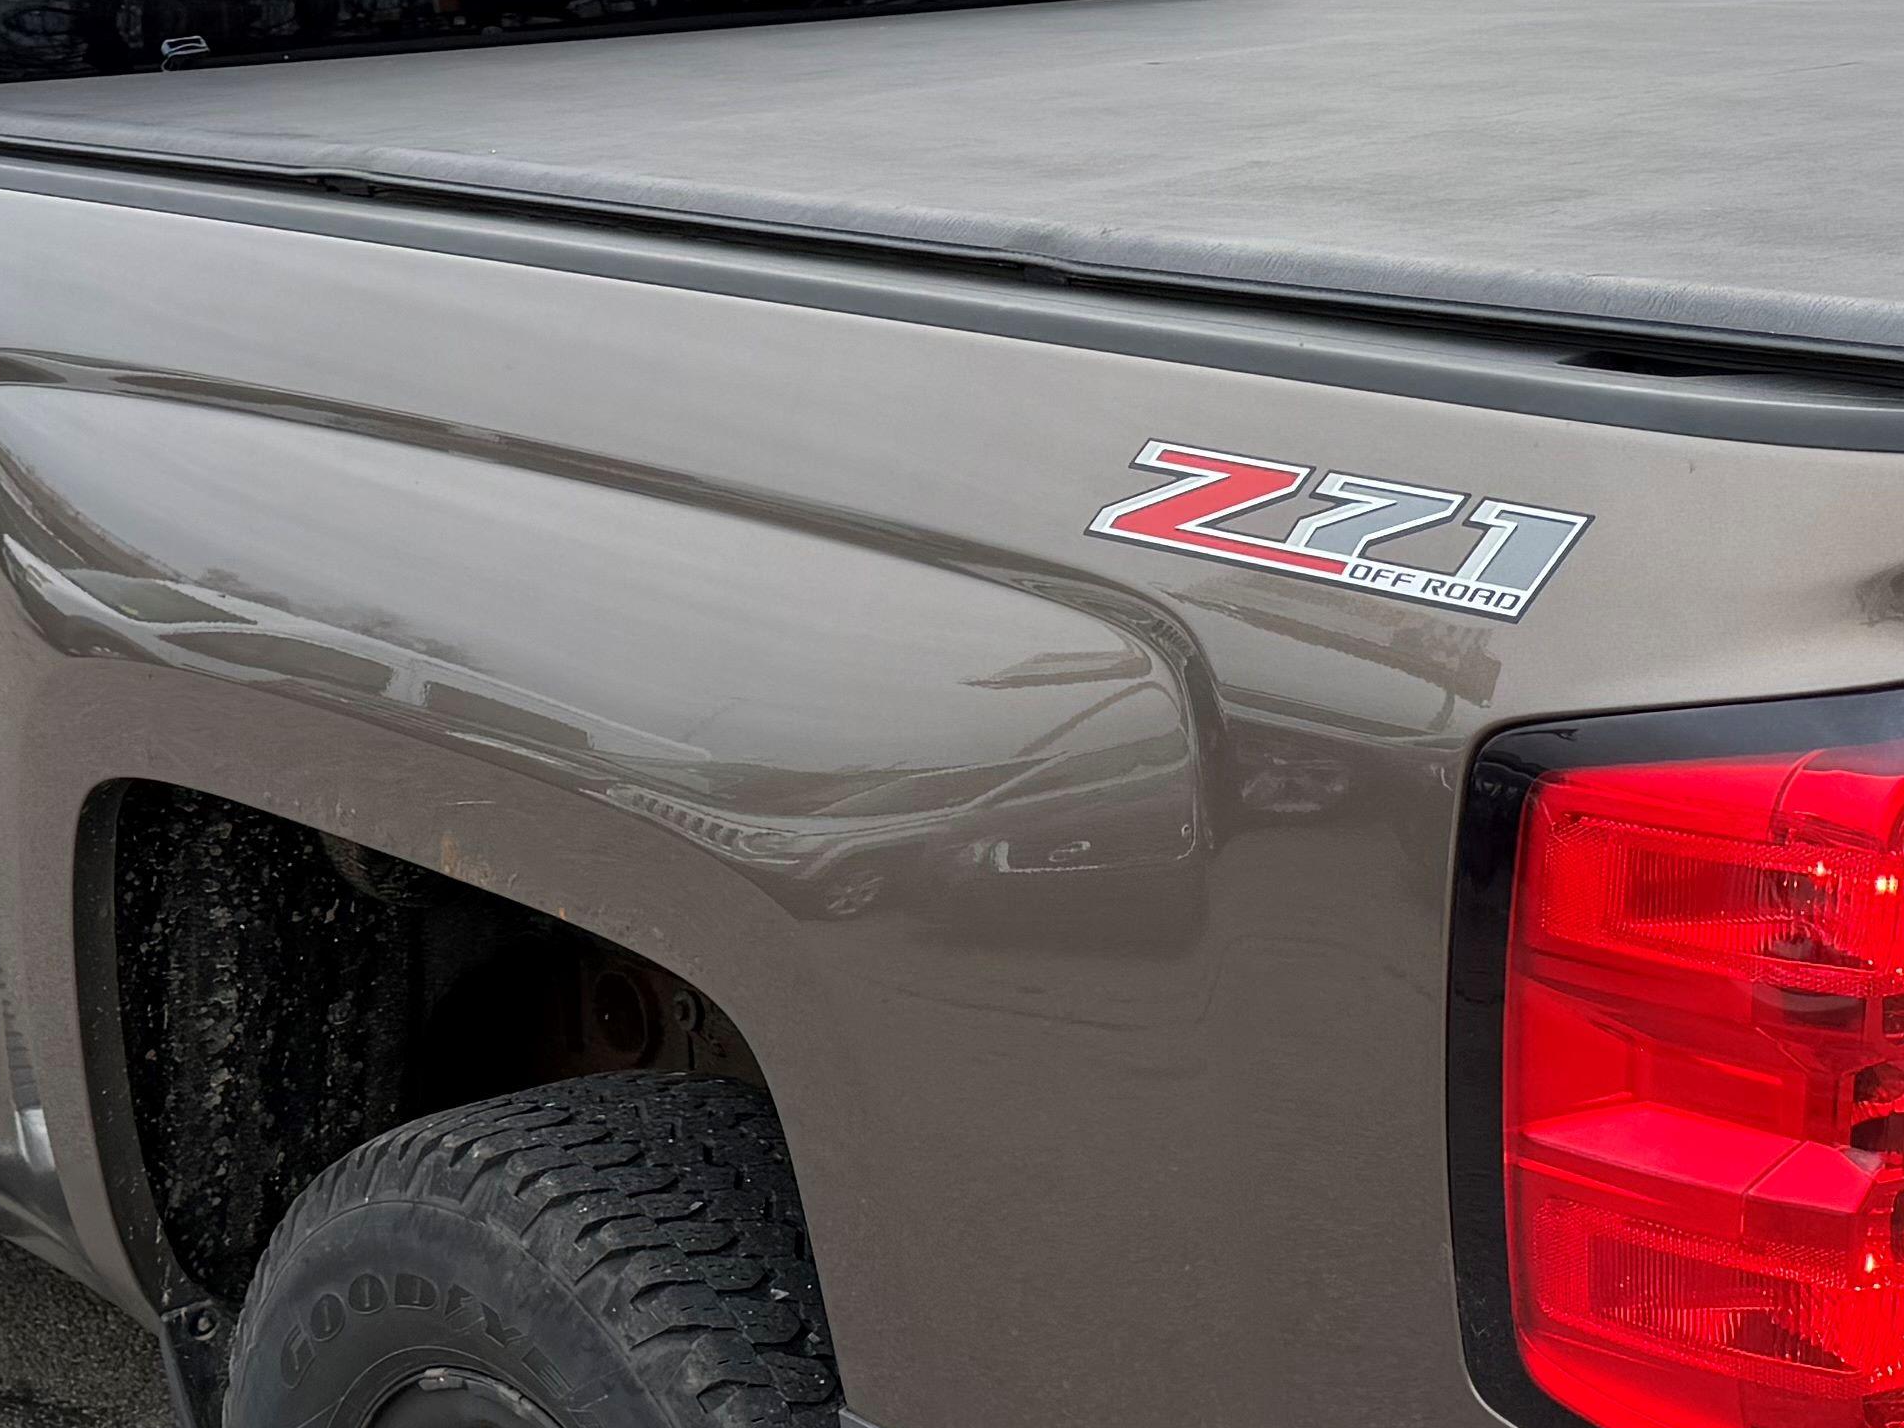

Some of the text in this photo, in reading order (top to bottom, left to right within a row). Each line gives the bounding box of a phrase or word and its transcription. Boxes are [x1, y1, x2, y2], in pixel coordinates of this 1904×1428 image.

[1084, 439, 1595, 594] Z71
[1348, 563, 1521, 611] OFF ROAD
